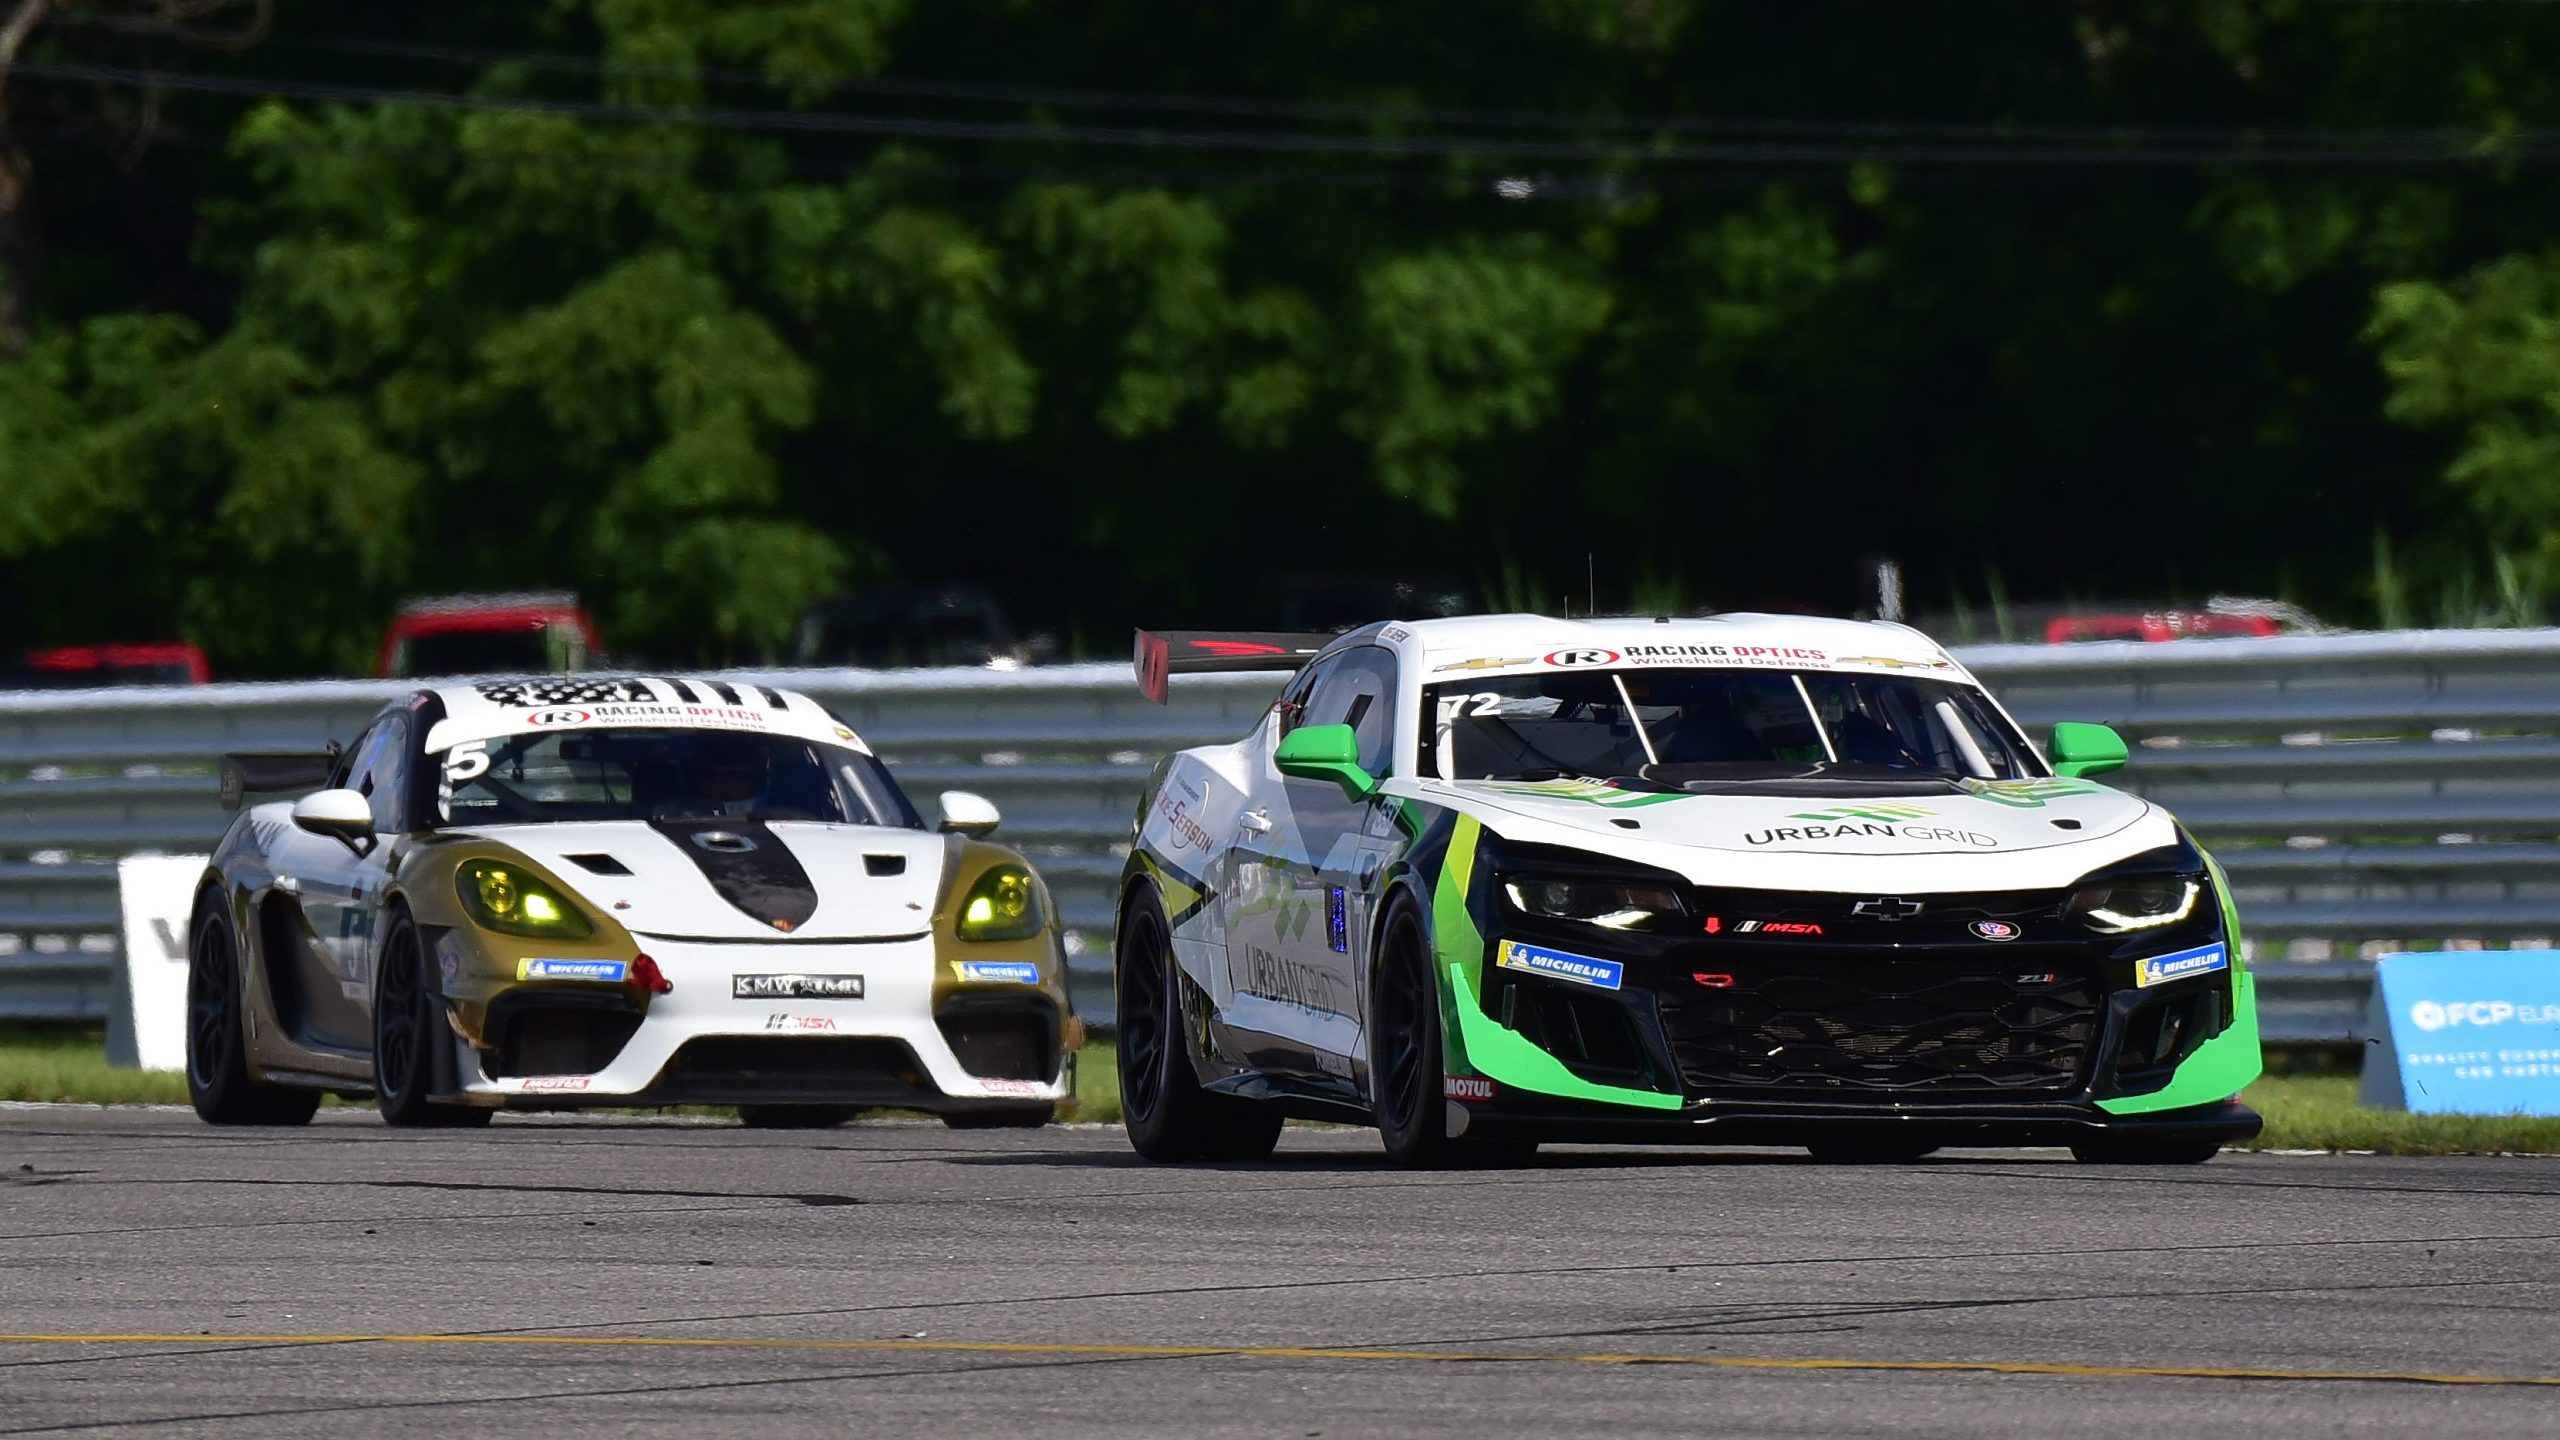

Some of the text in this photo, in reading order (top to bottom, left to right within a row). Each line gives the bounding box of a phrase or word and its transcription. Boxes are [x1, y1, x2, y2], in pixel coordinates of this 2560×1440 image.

[1624, 646, 1728, 657] RACING
[1733, 646, 1827, 660] OPTICS
[1629, 656, 1831, 669] Windshield Defense
[594, 706, 681, 717] RACING
[686, 706, 763, 722] OPTICS
[1439, 692, 1502, 718] 72
[446, 740, 490, 783] 5
[1168, 800, 1214, 855] SEASON
[1762, 923, 1823, 934] IMSA
[1531, 955, 1611, 979] MICHELIN
[2163, 953, 2220, 973] MICHELIN
[736, 977, 794, 995] KMW
[1446, 1079, 1492, 1098] MOTUL
